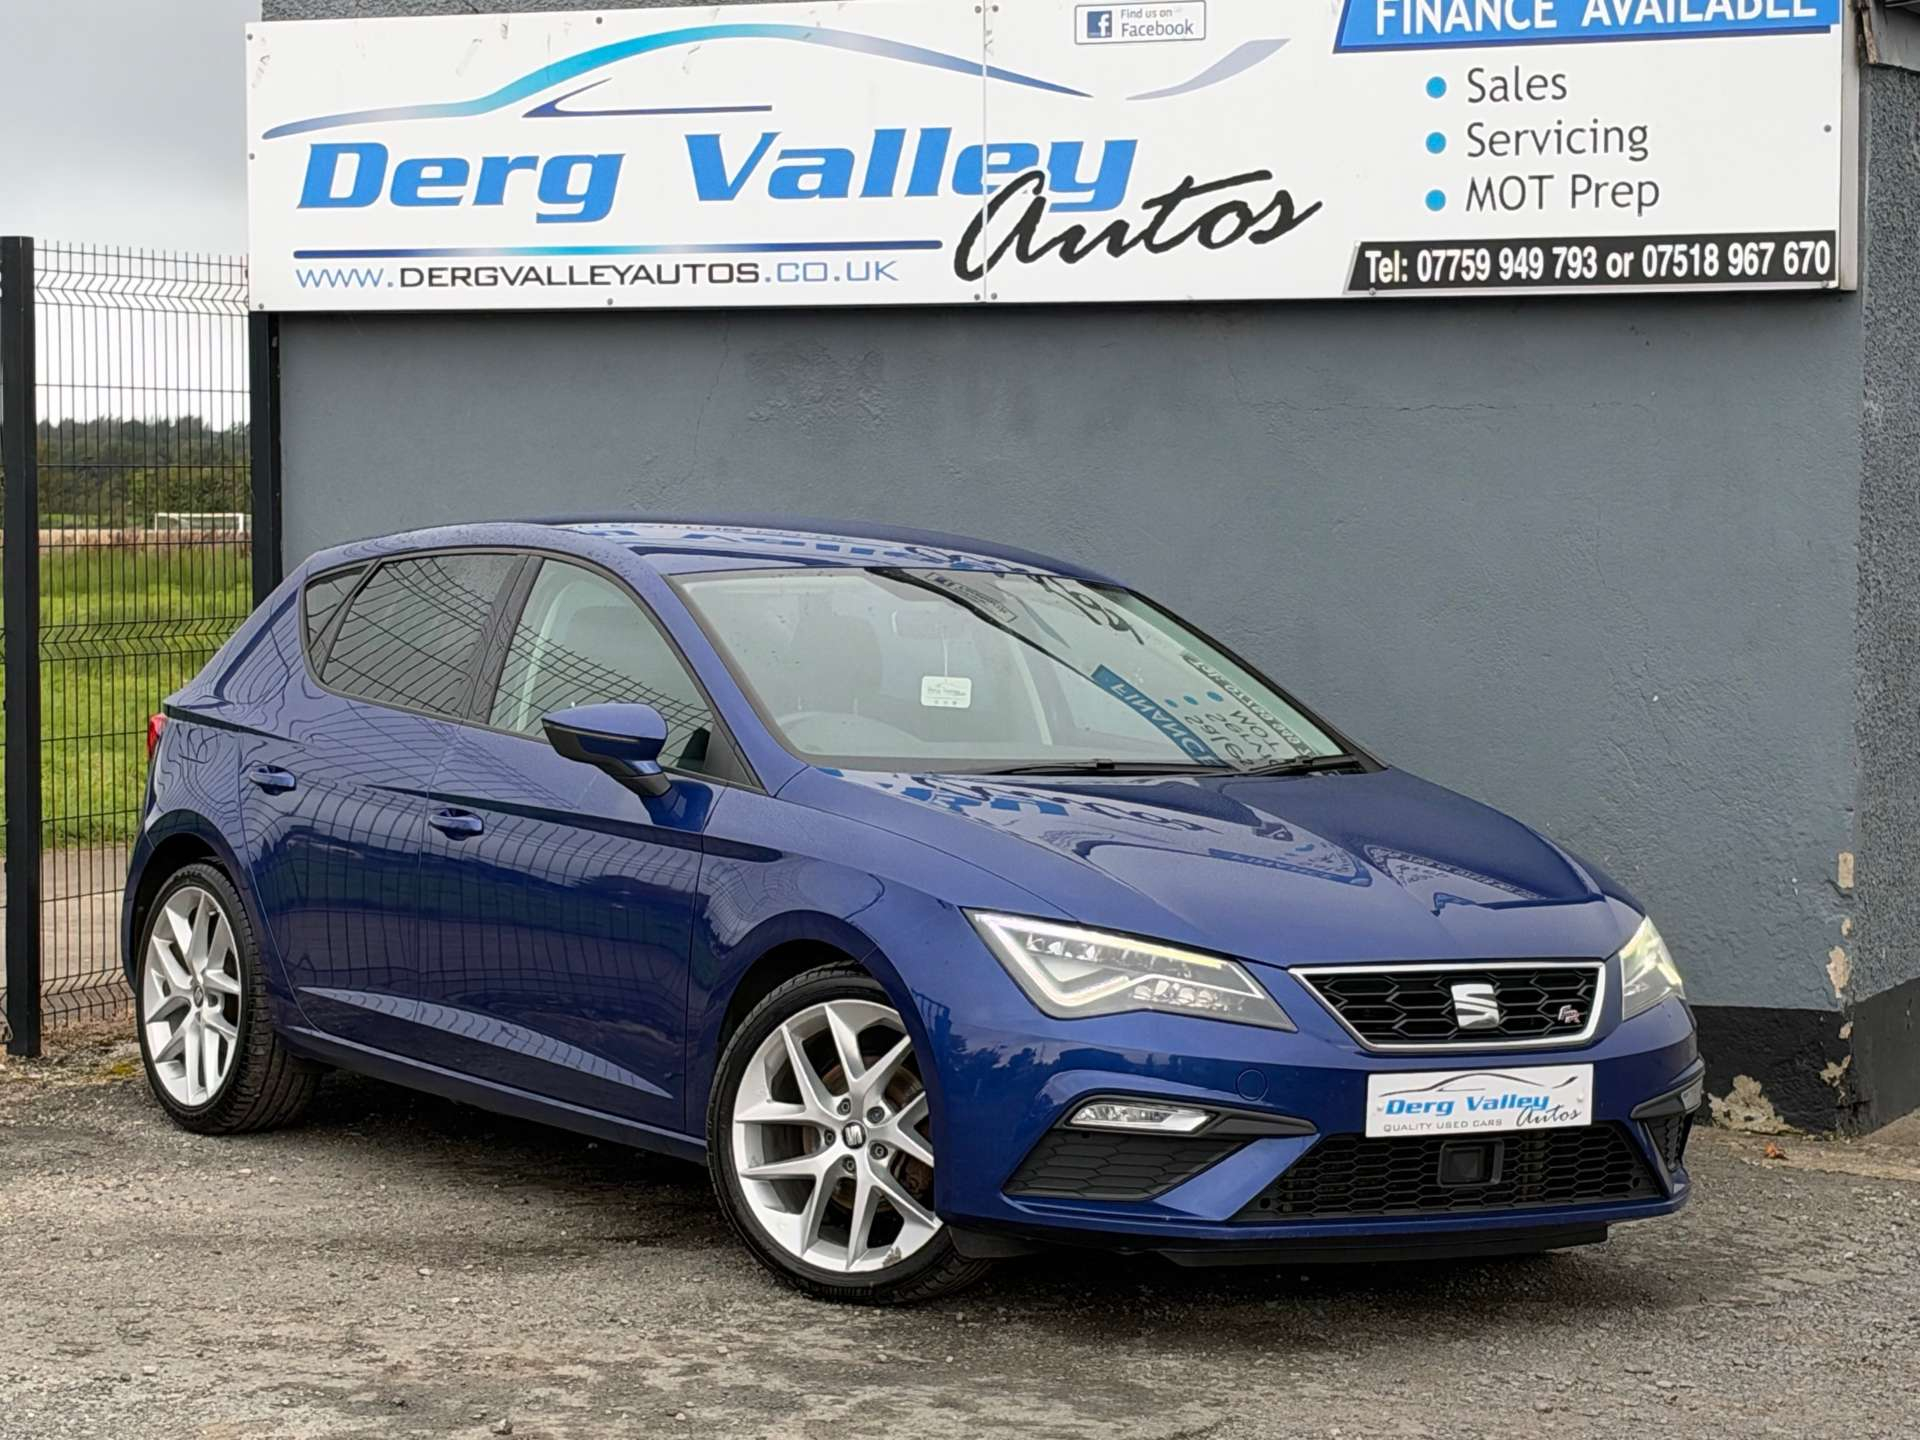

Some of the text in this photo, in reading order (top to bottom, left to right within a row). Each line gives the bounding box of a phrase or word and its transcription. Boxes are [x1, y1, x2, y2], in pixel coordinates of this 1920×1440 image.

[1121, 8, 1173, 19] Find us on
[1121, 18, 1195, 38] Facebook
[1376, 0, 1558, 35] FINANCE
[1467, 65, 1567, 104] Sales
[1466, 118, 1649, 162] Servicing
[297, 127, 1138, 224] Derg Valley
[1465, 174, 1660, 217] MOT Prep
[953, 169, 1324, 283] Autos
[1365, 240, 1831, 283] Tel: 07759 949 793 or 07518 967 670
[1384, 1093, 1550, 1117] Derg Valley
[1515, 1104, 1583, 1128] Autos
[1383, 1118, 1503, 1133] QUALITY USED CARS
